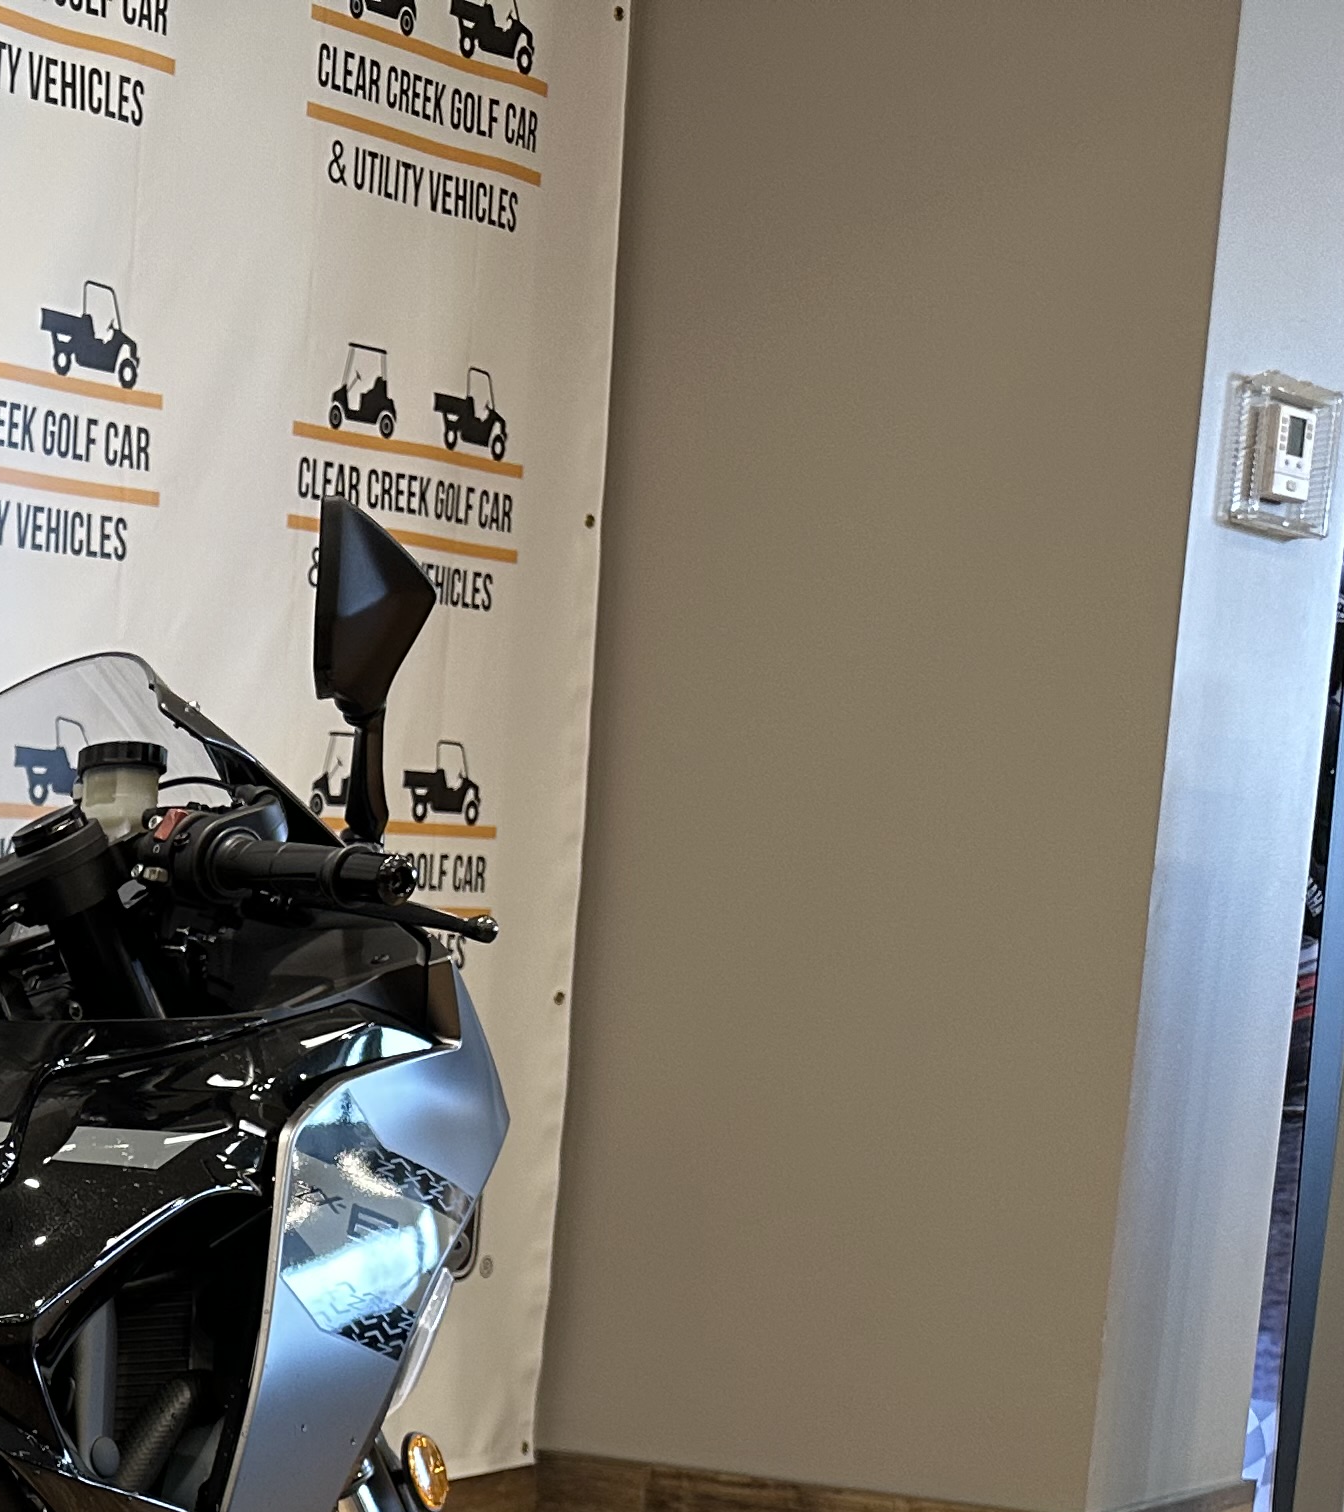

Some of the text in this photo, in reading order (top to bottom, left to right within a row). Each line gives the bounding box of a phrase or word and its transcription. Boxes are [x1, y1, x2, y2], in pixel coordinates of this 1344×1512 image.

[29, 52, 144, 126] VEHICLES
[318, 43, 538, 153] CLEAR CREEK GOLF CAR
[328, 140, 518, 232] & UTILITY VEHICLES
[44, 411, 98, 461] GOLF
[105, 422, 149, 471] CAR
[297, 456, 512, 533] CLEAR CREEK GOLF CAR
[18, 504, 126, 560] VEHICLES
[409, 853, 486, 892] OLF CAR
